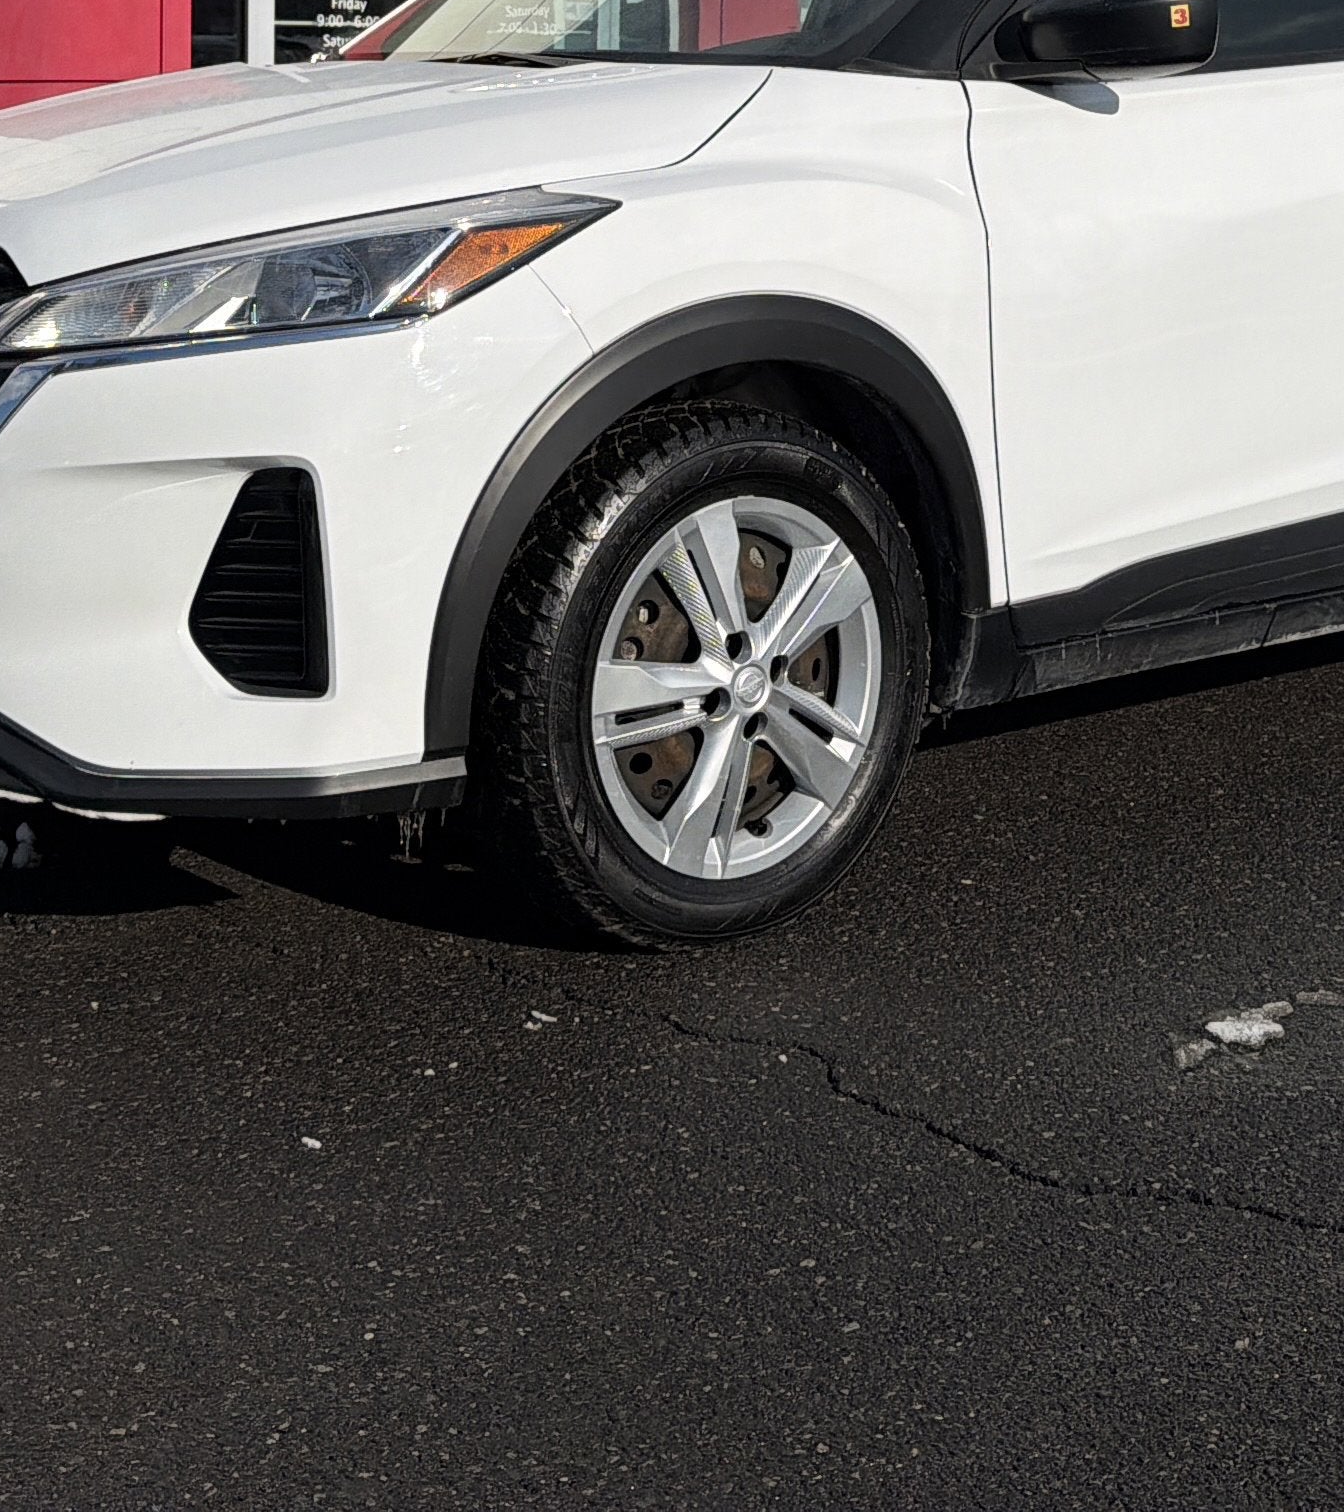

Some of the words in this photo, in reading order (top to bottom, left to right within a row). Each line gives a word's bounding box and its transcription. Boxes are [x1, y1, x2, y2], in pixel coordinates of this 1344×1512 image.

[506, 5, 551, 19] Saturday
[1174, 8, 1188, 25] 3
[317, 14, 344, 27] 9:00
